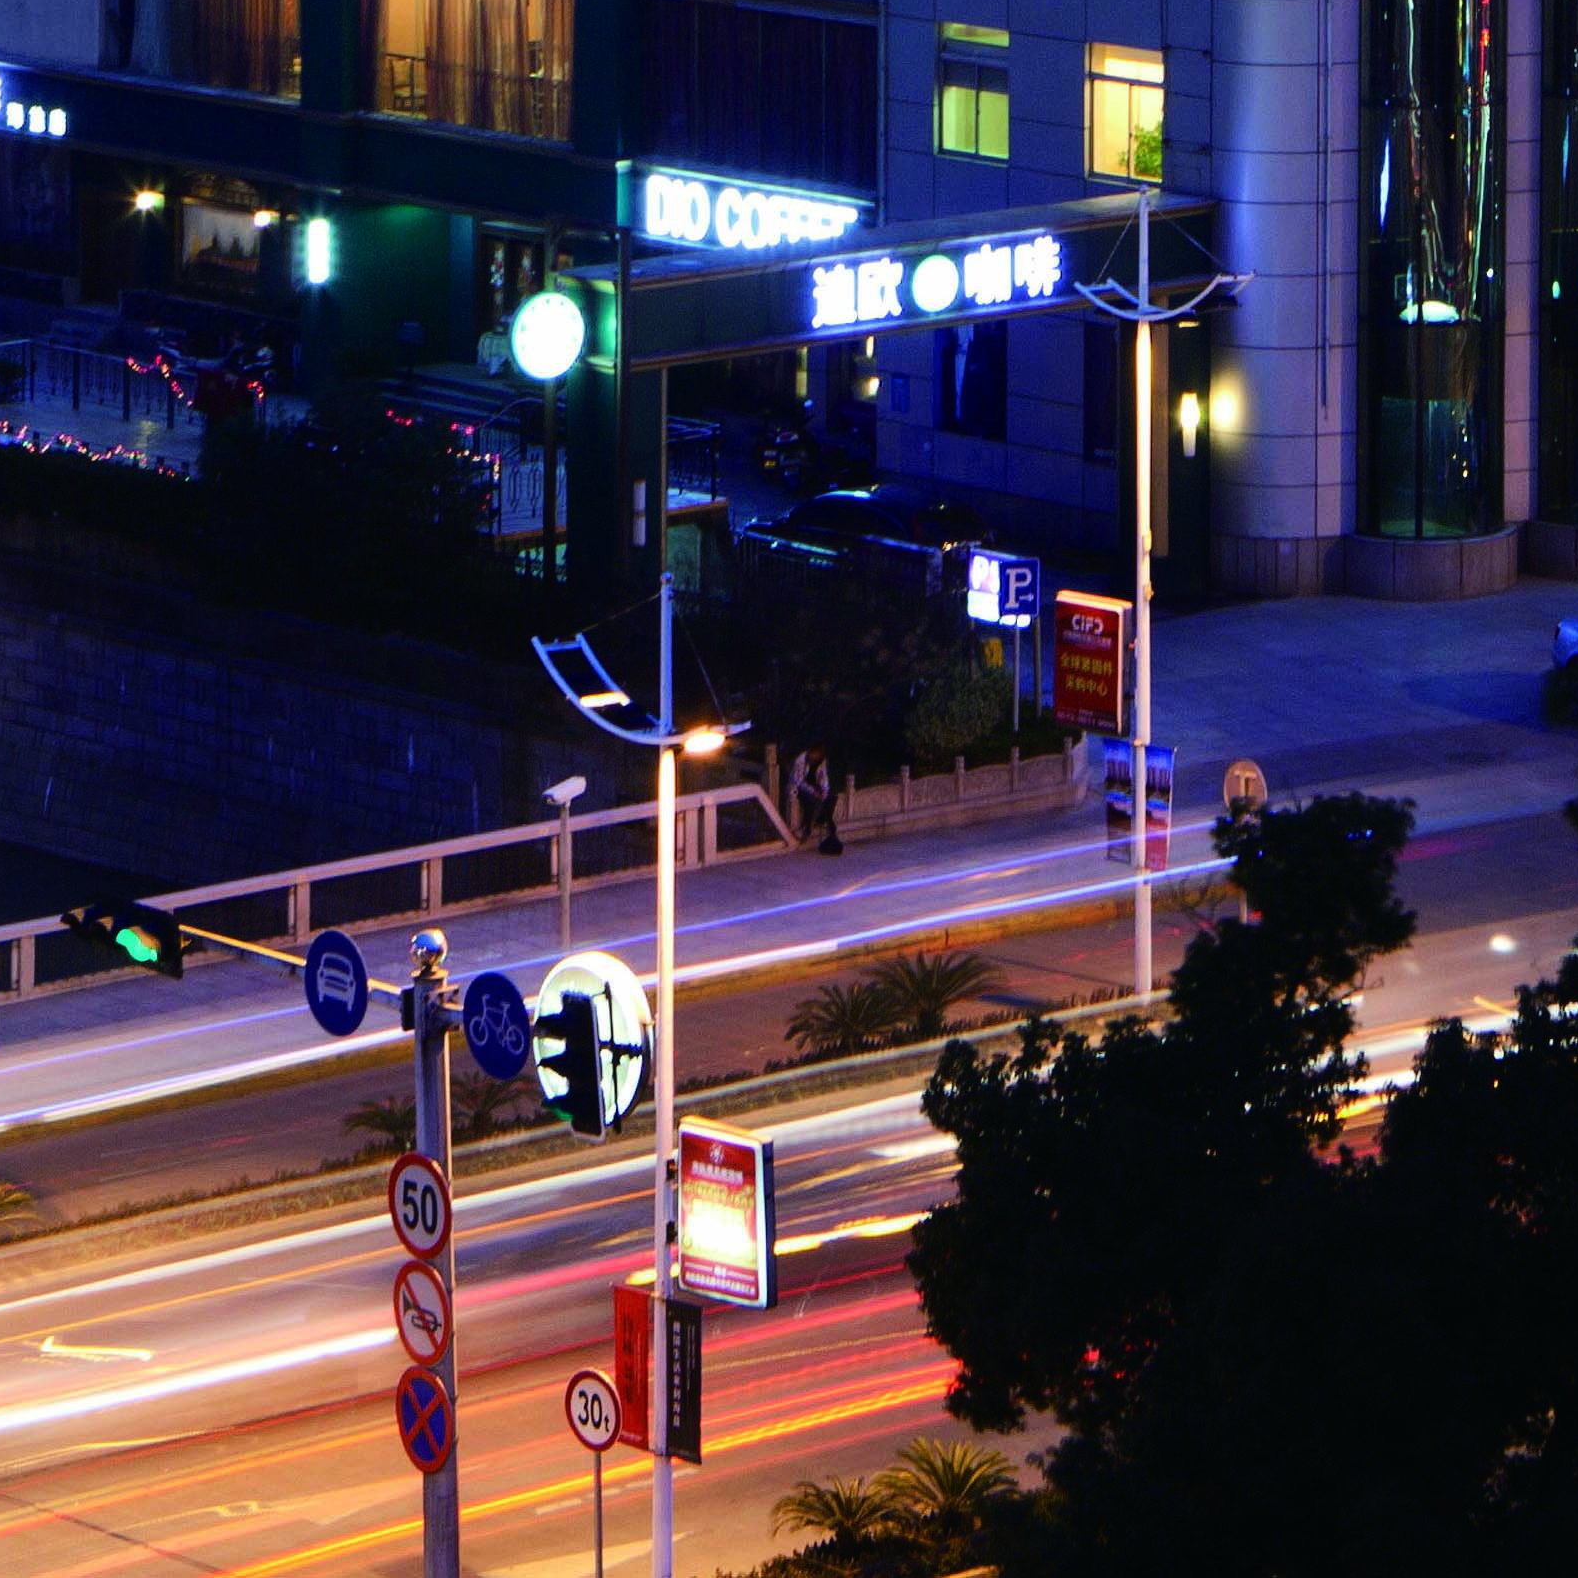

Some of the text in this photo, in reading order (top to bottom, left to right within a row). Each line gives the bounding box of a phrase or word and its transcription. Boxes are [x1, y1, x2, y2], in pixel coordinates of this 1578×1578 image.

[646, 174, 710, 240] DIO
[1005, 568, 1032, 609] P
[402, 1180, 439, 1237] 50
